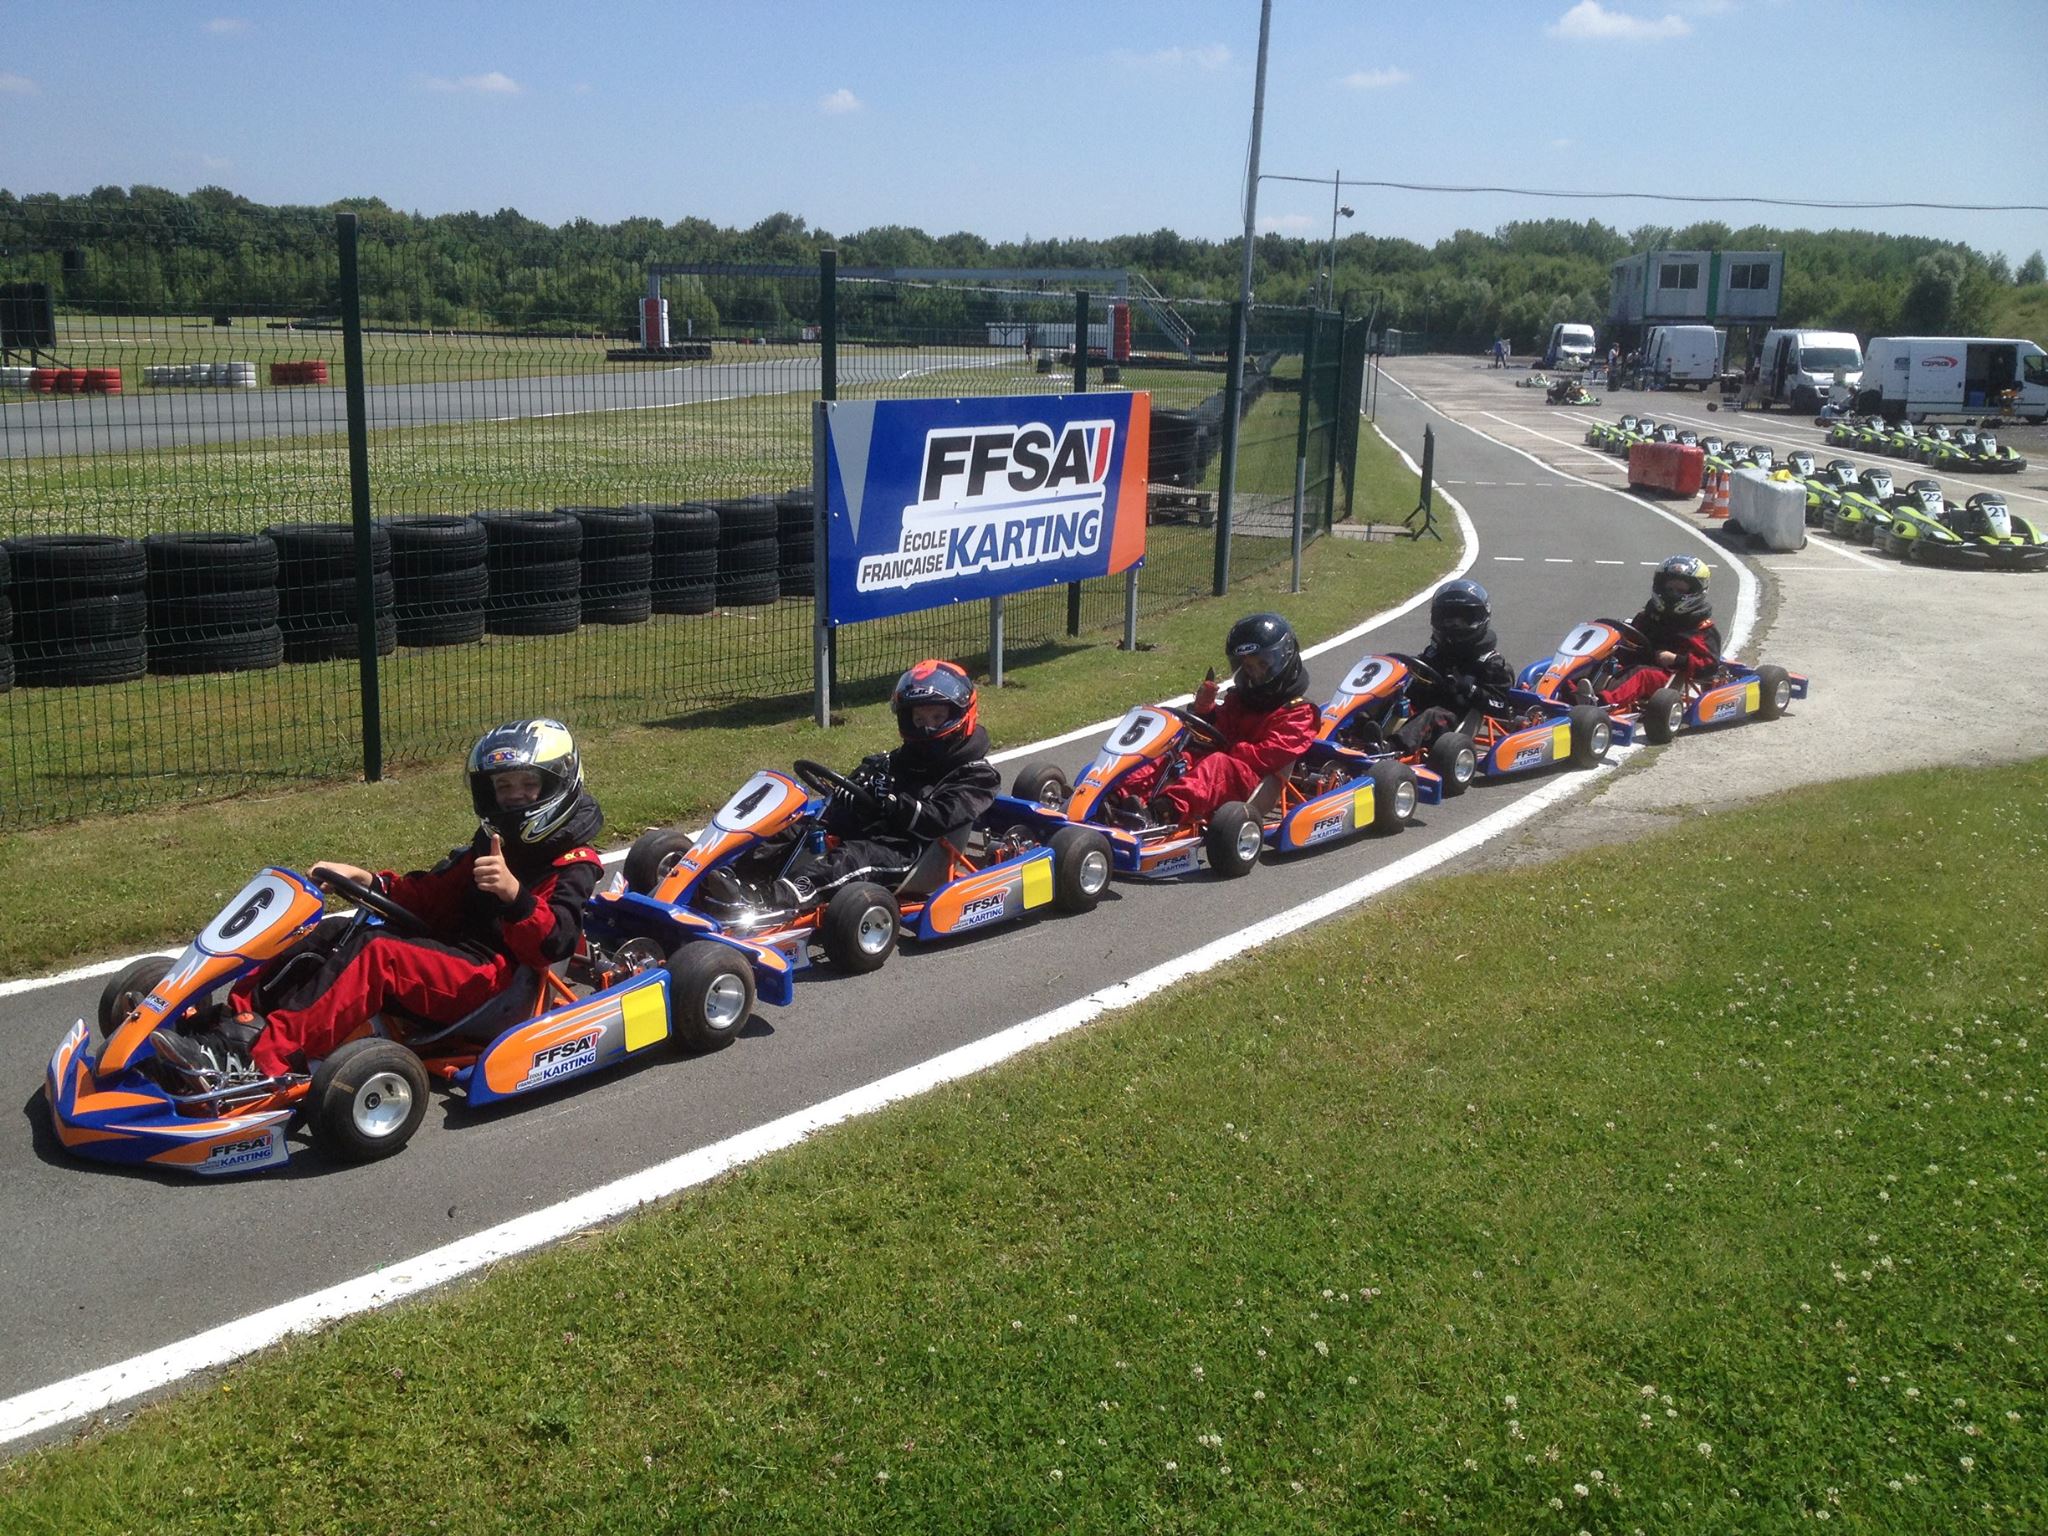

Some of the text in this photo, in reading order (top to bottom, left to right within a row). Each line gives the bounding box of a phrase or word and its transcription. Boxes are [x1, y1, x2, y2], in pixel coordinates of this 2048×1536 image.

[922, 428, 1091, 502] FFSA
[1802, 459, 1810, 470] 4
[1844, 469, 1853, 478] 9
[1876, 479, 1890, 489] 17
[1922, 492, 1942, 503] 22
[1987, 506, 2007, 518] 21
[903, 529, 947, 552] ÉCOLE
[944, 508, 1100, 572] KARTING
[861, 553, 944, 585] FRANÇAISE
[1571, 629, 1596, 651] 1
[1351, 662, 1382, 688] 3
[1118, 714, 1154, 747] 5
[733, 782, 775, 821] 4
[1312, 815, 1340, 832] FFSA
[218, 887, 275, 940] 6
[963, 895, 1000, 916] FFSA
[969, 907, 1003, 925] KARTING
[534, 1035, 591, 1069] FFSA
[543, 1051, 595, 1080] KARTING
[212, 1136, 265, 1158] FFSA
[220, 1148, 271, 1167] KARTING
